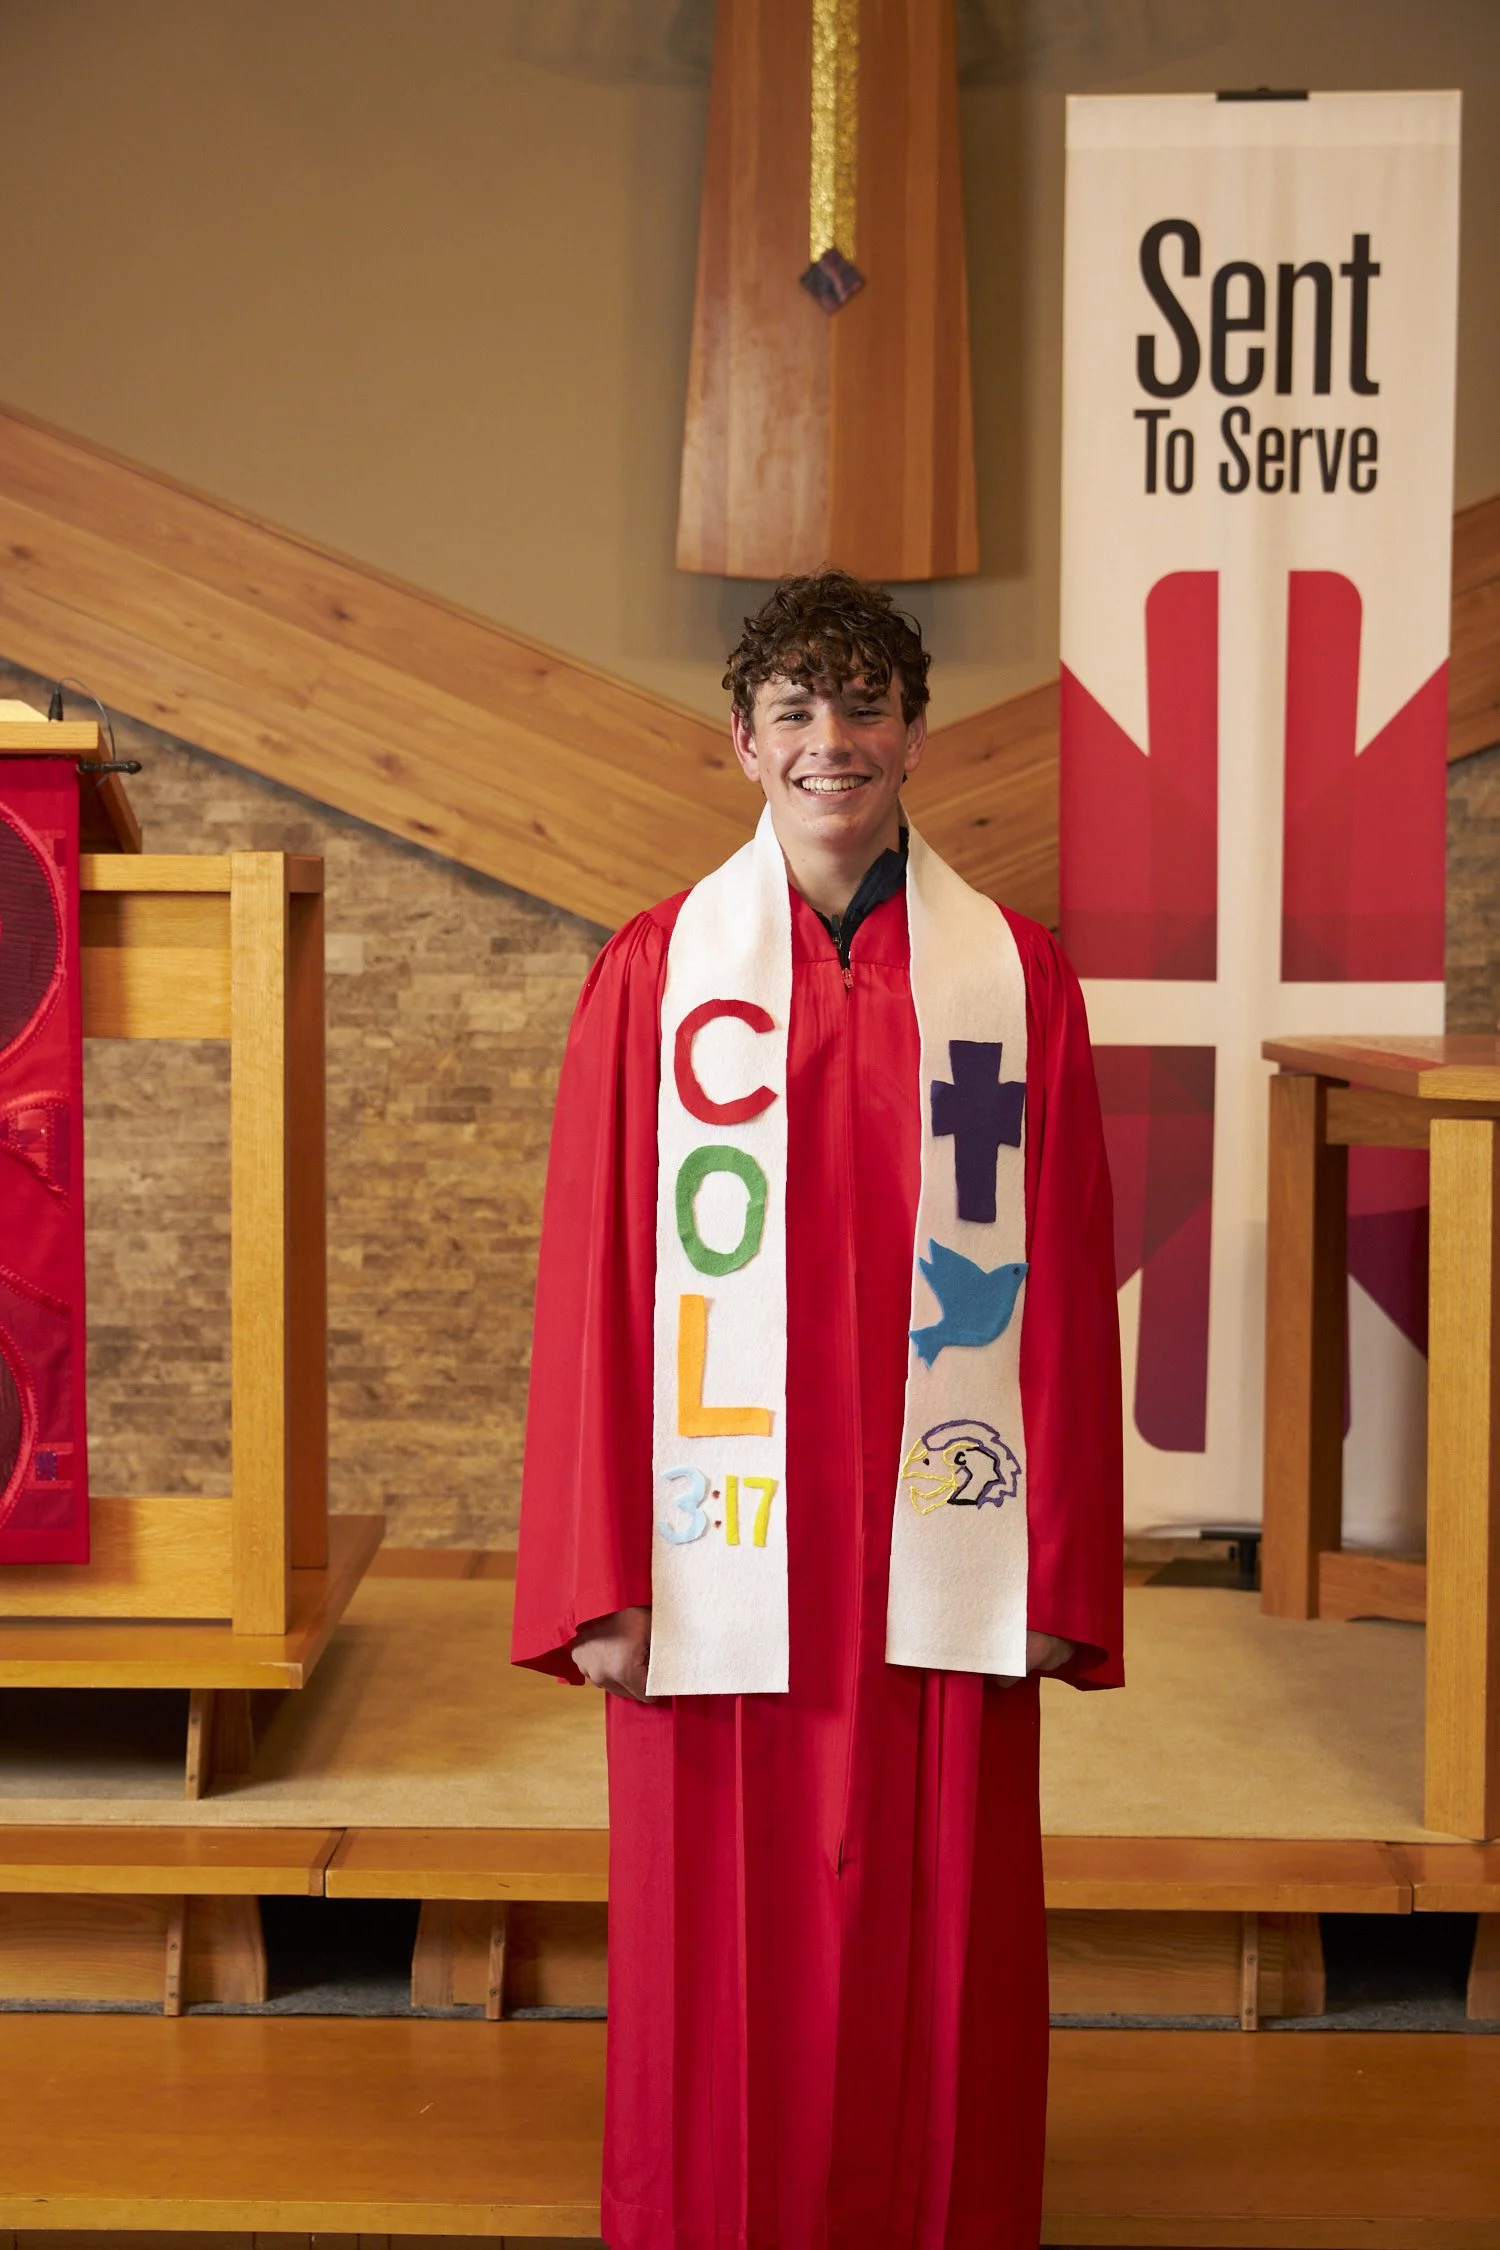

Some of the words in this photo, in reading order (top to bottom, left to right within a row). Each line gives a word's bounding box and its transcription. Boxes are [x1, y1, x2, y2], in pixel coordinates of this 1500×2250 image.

[1136, 217, 1381, 399] Sent
[1133, 408, 1195, 495] To
[1218, 405, 1379, 495] Serve
[660, 1466, 777, 1549] 3:17
